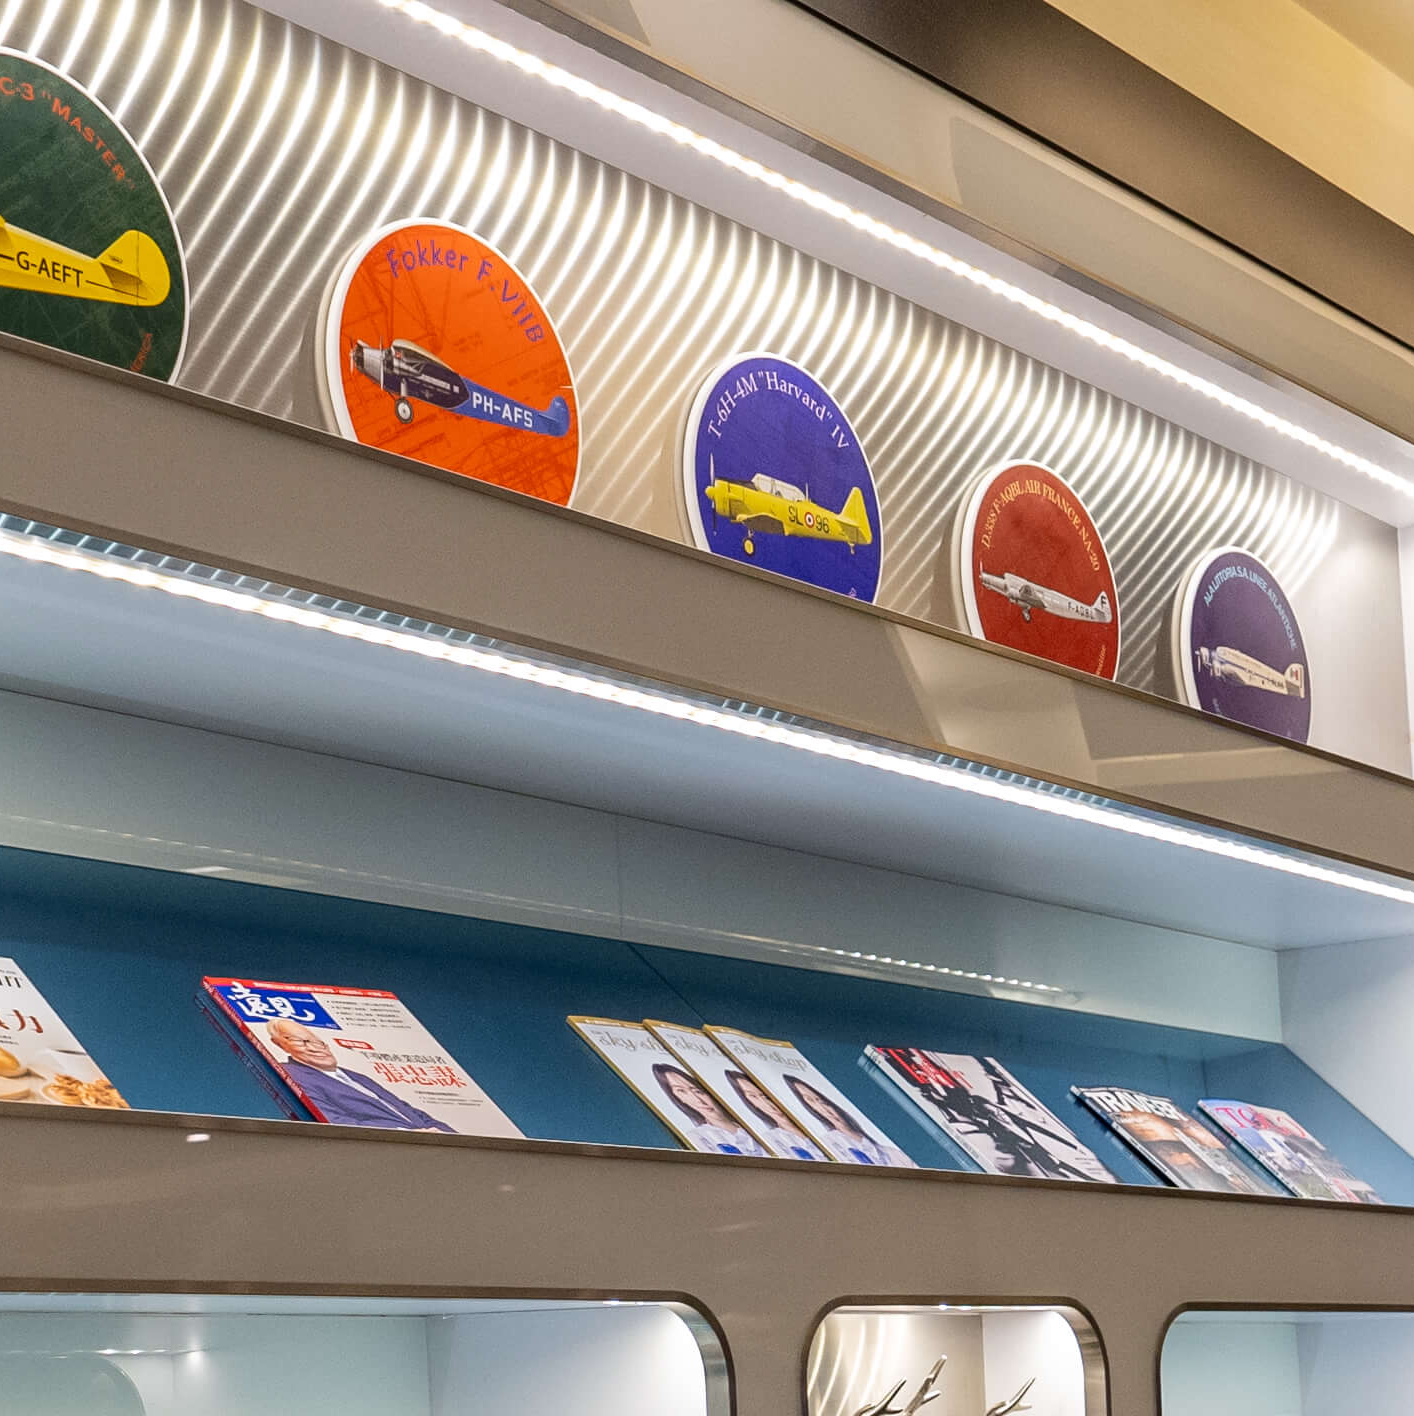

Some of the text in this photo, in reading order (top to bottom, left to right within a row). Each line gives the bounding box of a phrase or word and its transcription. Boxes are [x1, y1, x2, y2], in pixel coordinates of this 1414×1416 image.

[16, 251, 84, 288] G-AEFT
[387, 240, 469, 278] Fokker
[472, 391, 533, 428] PH-AFS
[707, 373, 758, 440] T-6H-4M
[831, 425, 849, 449] IV
[788, 505, 830, 534] SL 96
[1025, 480, 1041, 495] AIR
[1042, 484, 1081, 529] FRANCE
[227, 981, 316, 1022] 遠見
